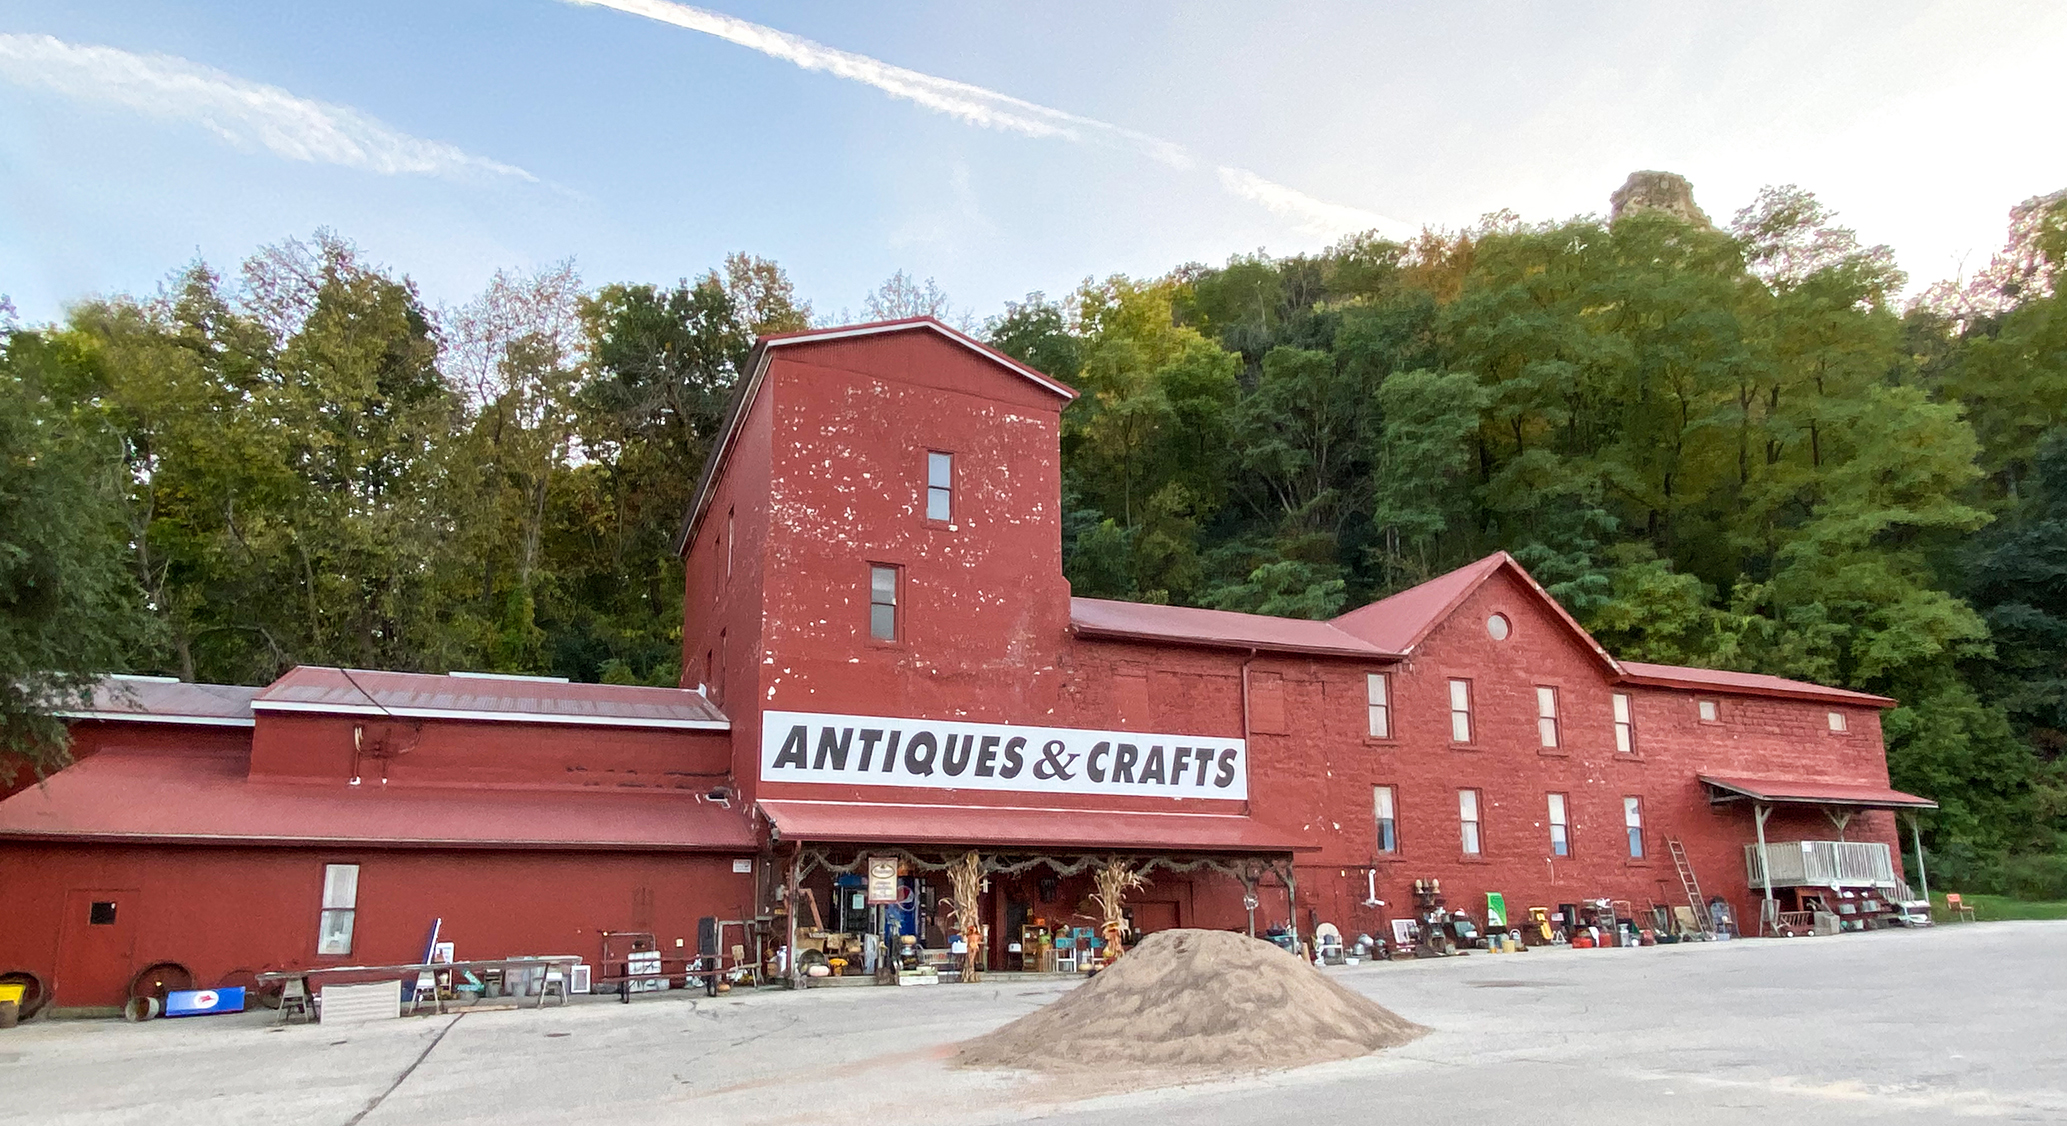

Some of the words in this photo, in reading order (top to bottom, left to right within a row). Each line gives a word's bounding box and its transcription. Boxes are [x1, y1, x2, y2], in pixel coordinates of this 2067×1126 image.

[772, 725, 1027, 779] ANTIQUES
[1033, 740, 1080, 781] &
[1086, 741, 1238, 788] CRAFTS
